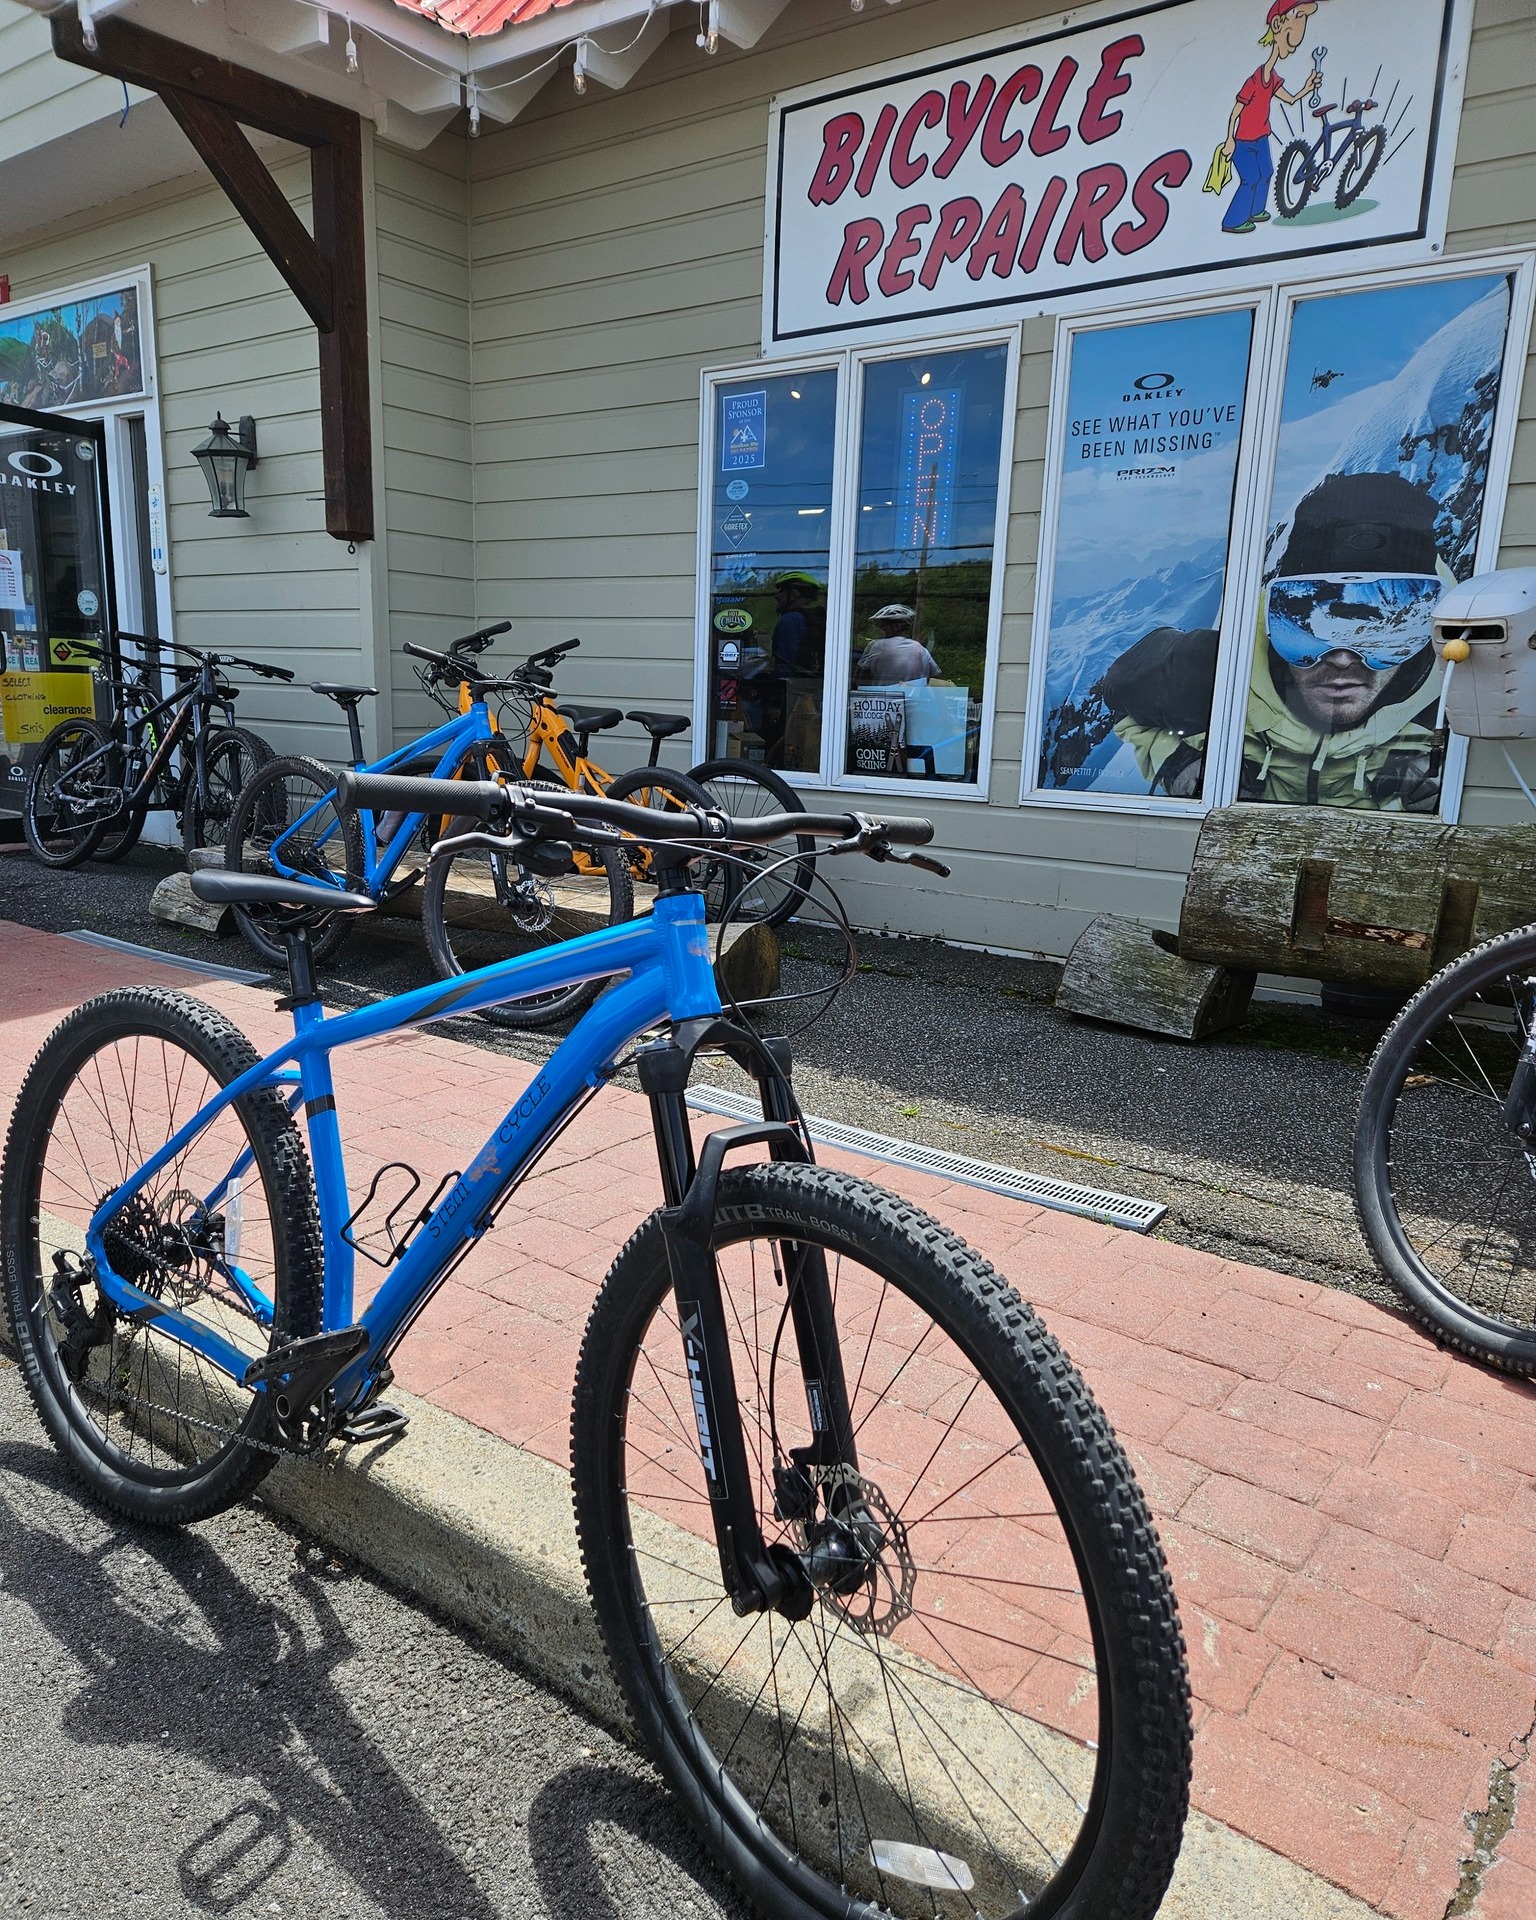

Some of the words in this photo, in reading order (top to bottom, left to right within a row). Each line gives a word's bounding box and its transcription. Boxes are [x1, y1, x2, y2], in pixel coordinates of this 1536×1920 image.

[808, 34, 1145, 207] BICYCLE
[825, 149, 1192, 306] REPAIRS
[1122, 388, 1185, 402] OAKLEY
[732, 399, 758, 410] PROUD
[728, 408, 762, 419] SPONSOR
[1071, 418, 1102, 437] SEE
[1109, 412, 1161, 433] WHAT
[1169, 405, 1236, 427] YOU'VE
[1081, 440, 1126, 459] BEEN
[732, 454, 755, 465] 2025
[913, 398, 946, 545] OPEN
[723, 523, 748, 531] GORE-TEX
[2, 677, 31, 687] SELECT
[43, 704, 92, 715] clearance
[853, 700, 902, 713] HOLIDAY
[864, 711, 885, 720] LODGE
[856, 748, 886, 761] GONE
[856, 760, 887, 770] SKIING
[428, 1181, 471, 1239] STEM
[499, 1075, 552, 1144] CYCLE
[765, 1206, 807, 1224] TRAIL
[809, 1215, 851, 1241] BOSS
[6, 1249, 17, 1282] BOSS
[11, 1285, 24, 1319] TRAIL
[15, 1320, 41, 1377] WTB
